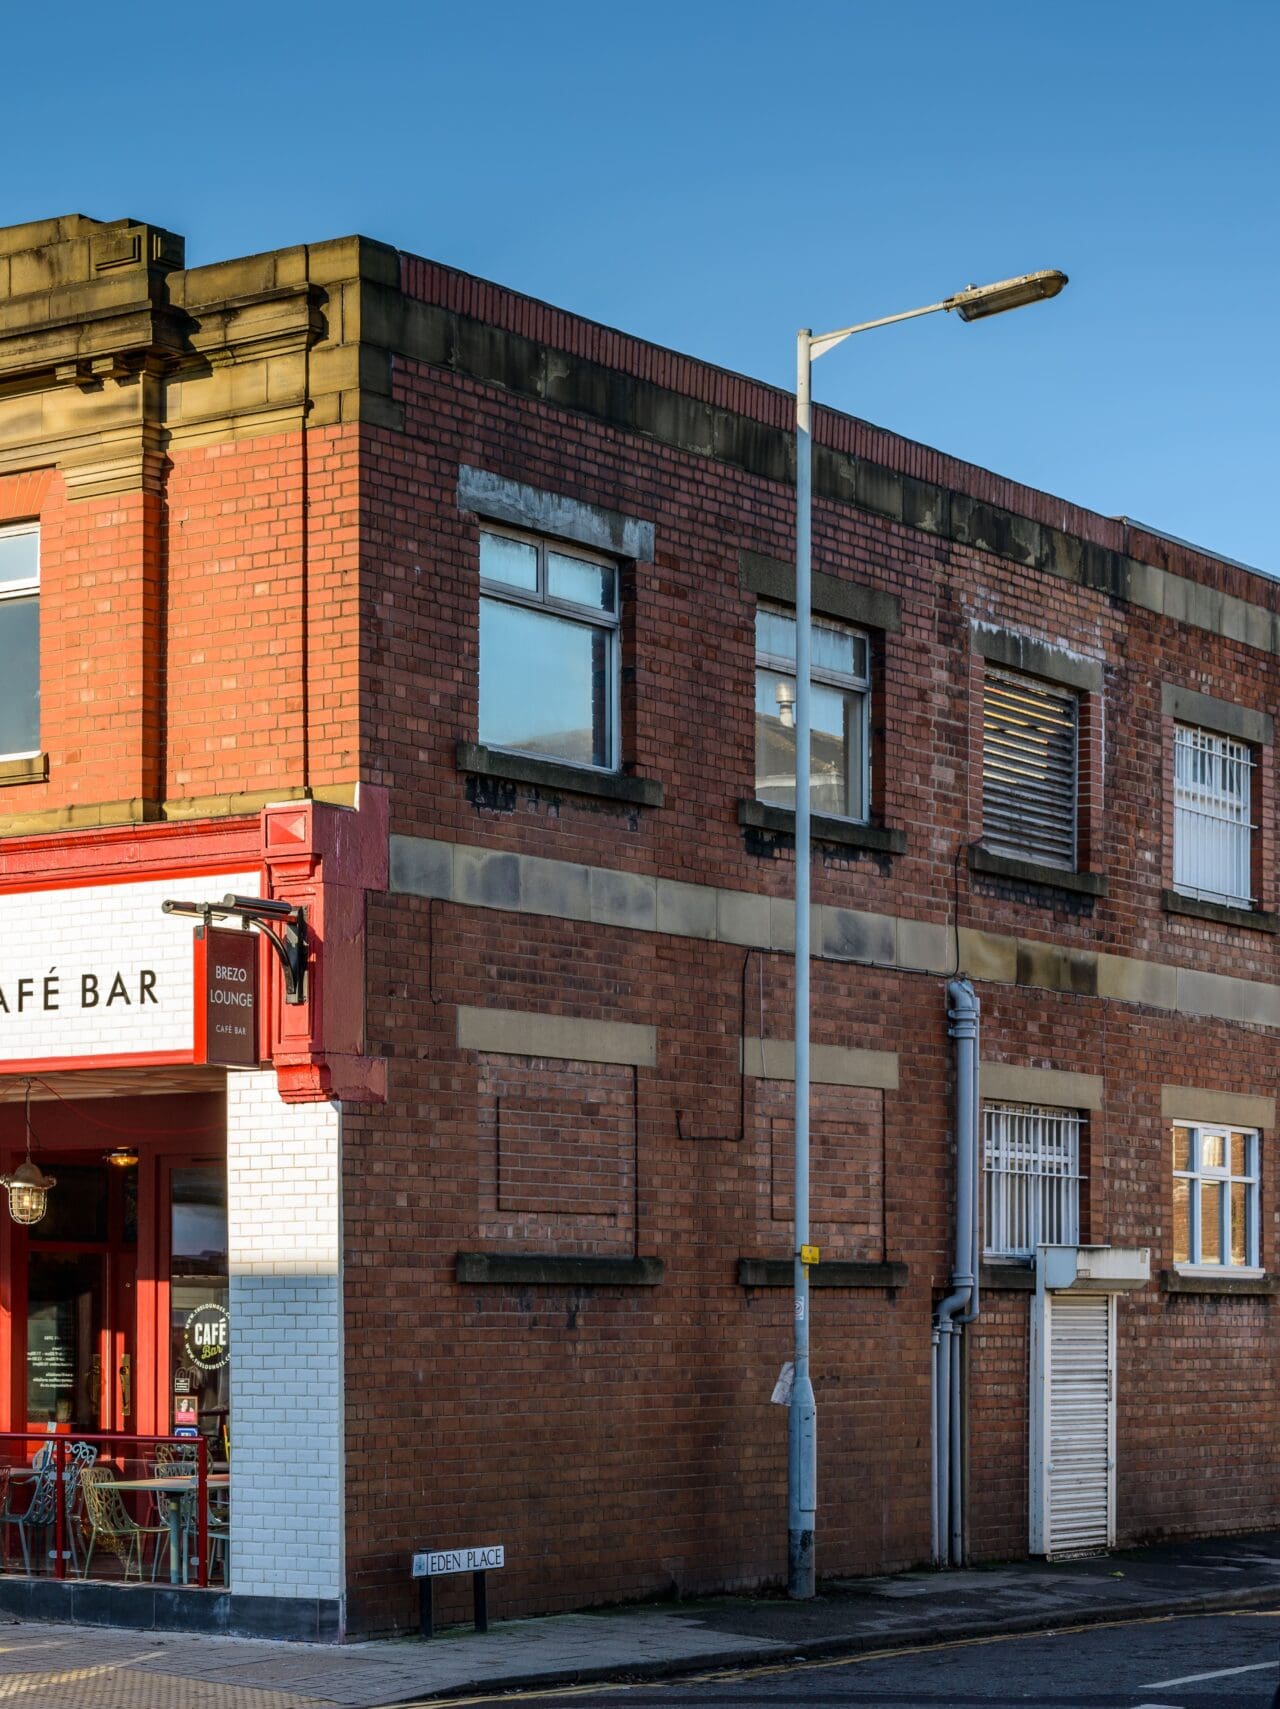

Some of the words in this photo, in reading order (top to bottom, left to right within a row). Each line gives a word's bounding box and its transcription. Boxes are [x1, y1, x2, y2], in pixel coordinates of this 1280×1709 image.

[215, 965, 247, 982] BREZO
[81, 970, 159, 1008] BAR
[210, 989, 253, 1007] LOUNGE
[234, 1026, 247, 1035] BAR
[194, 1317, 227, 1346] CAFÉ
[201, 1344, 224, 1359] Bar
[430, 1552, 461, 1573] EDEN
[467, 1548, 501, 1569] PLACE
